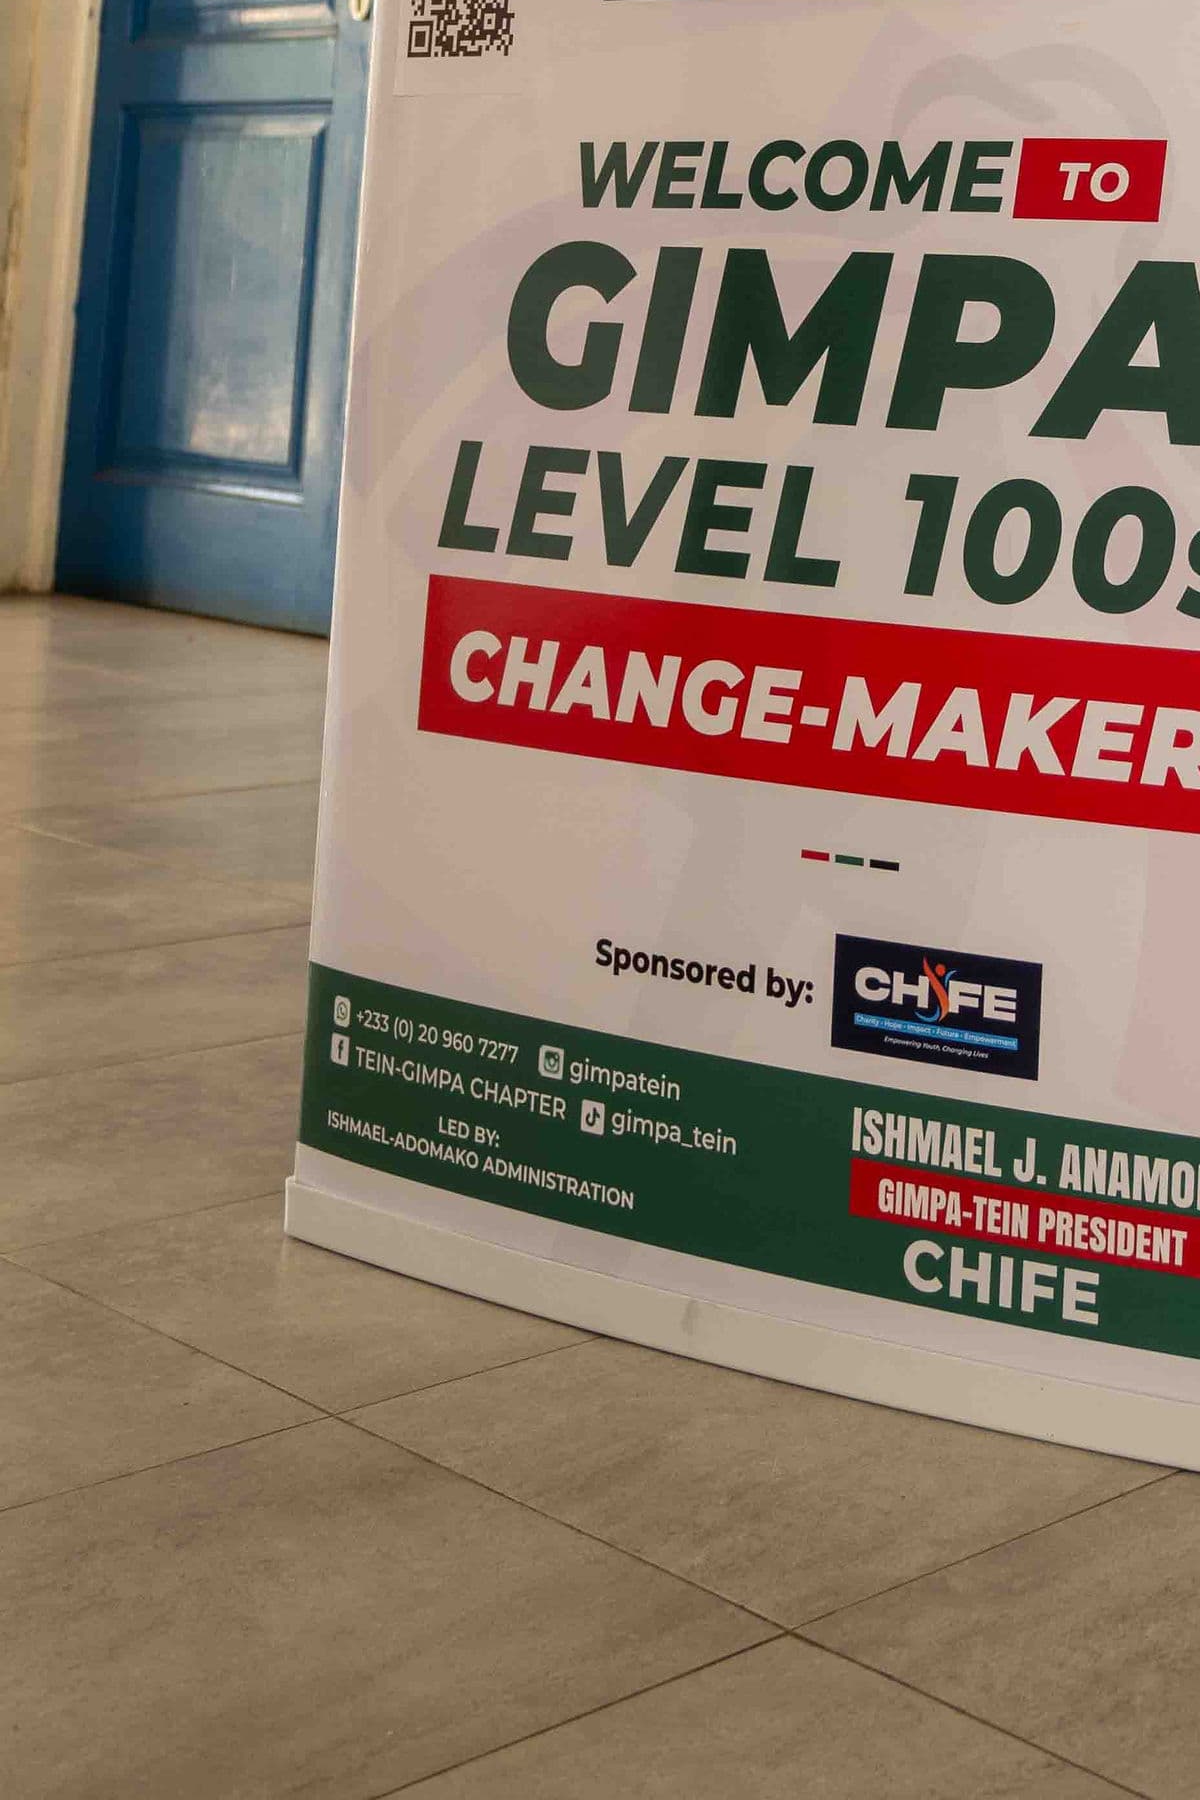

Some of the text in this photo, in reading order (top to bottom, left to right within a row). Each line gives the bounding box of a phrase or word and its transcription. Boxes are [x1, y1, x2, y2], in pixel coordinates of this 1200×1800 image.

[579, 139, 1131, 213] WELCOME TO
[437, 440, 840, 588] LEVEL
[595, 938, 814, 1008] Sponsored by:
[356, 1008, 519, 1065] +233 (0) 20 960 7277
[355, 1046, 567, 1120] TEIN-GIMPA CHAPTER
[569, 1059, 681, 1101] gimpatein
[327, 1109, 635, 1210] ISHMAEL-ADOMAKO ADMINISTRATION
[438, 1115, 500, 1148] LED BY:
[611, 1110, 737, 1156] gimpa_tein
[851, 1106, 1002, 1179] ISHMAEL
[1013, 1137, 1047, 1185] J.
[877, 1177, 1188, 1267] GIMPA-TEIN PRESIDENT
[903, 1239, 1100, 1326] CHIFE
